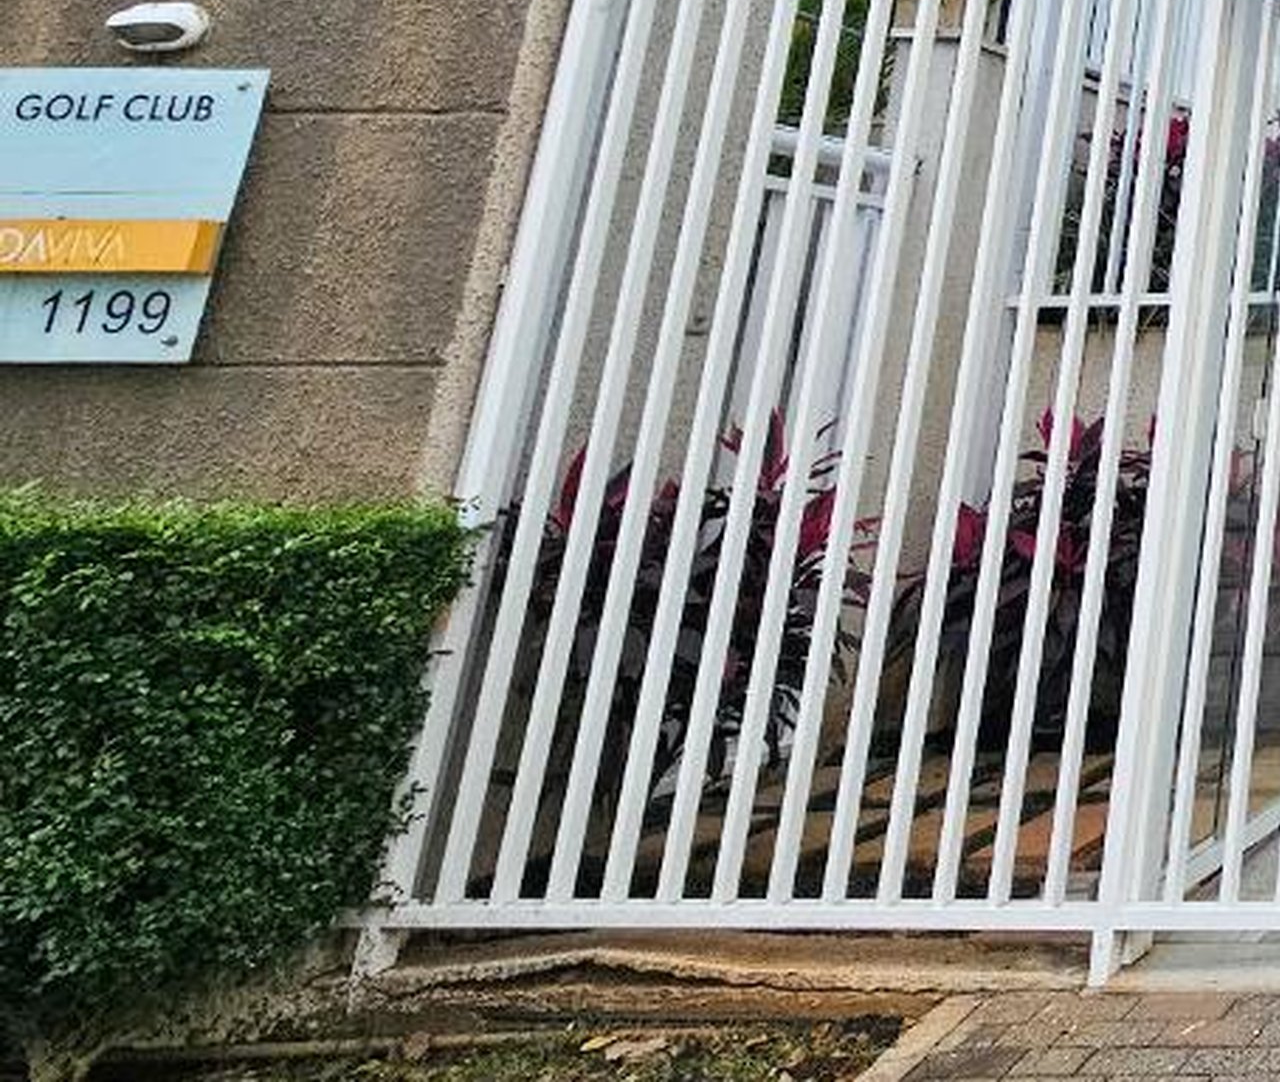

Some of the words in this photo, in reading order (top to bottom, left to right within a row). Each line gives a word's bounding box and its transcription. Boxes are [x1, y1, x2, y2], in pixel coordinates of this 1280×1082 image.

[15, 93, 114, 121] GOLF
[123, 93, 215, 121] CLUB
[42, 288, 172, 334] 1199
